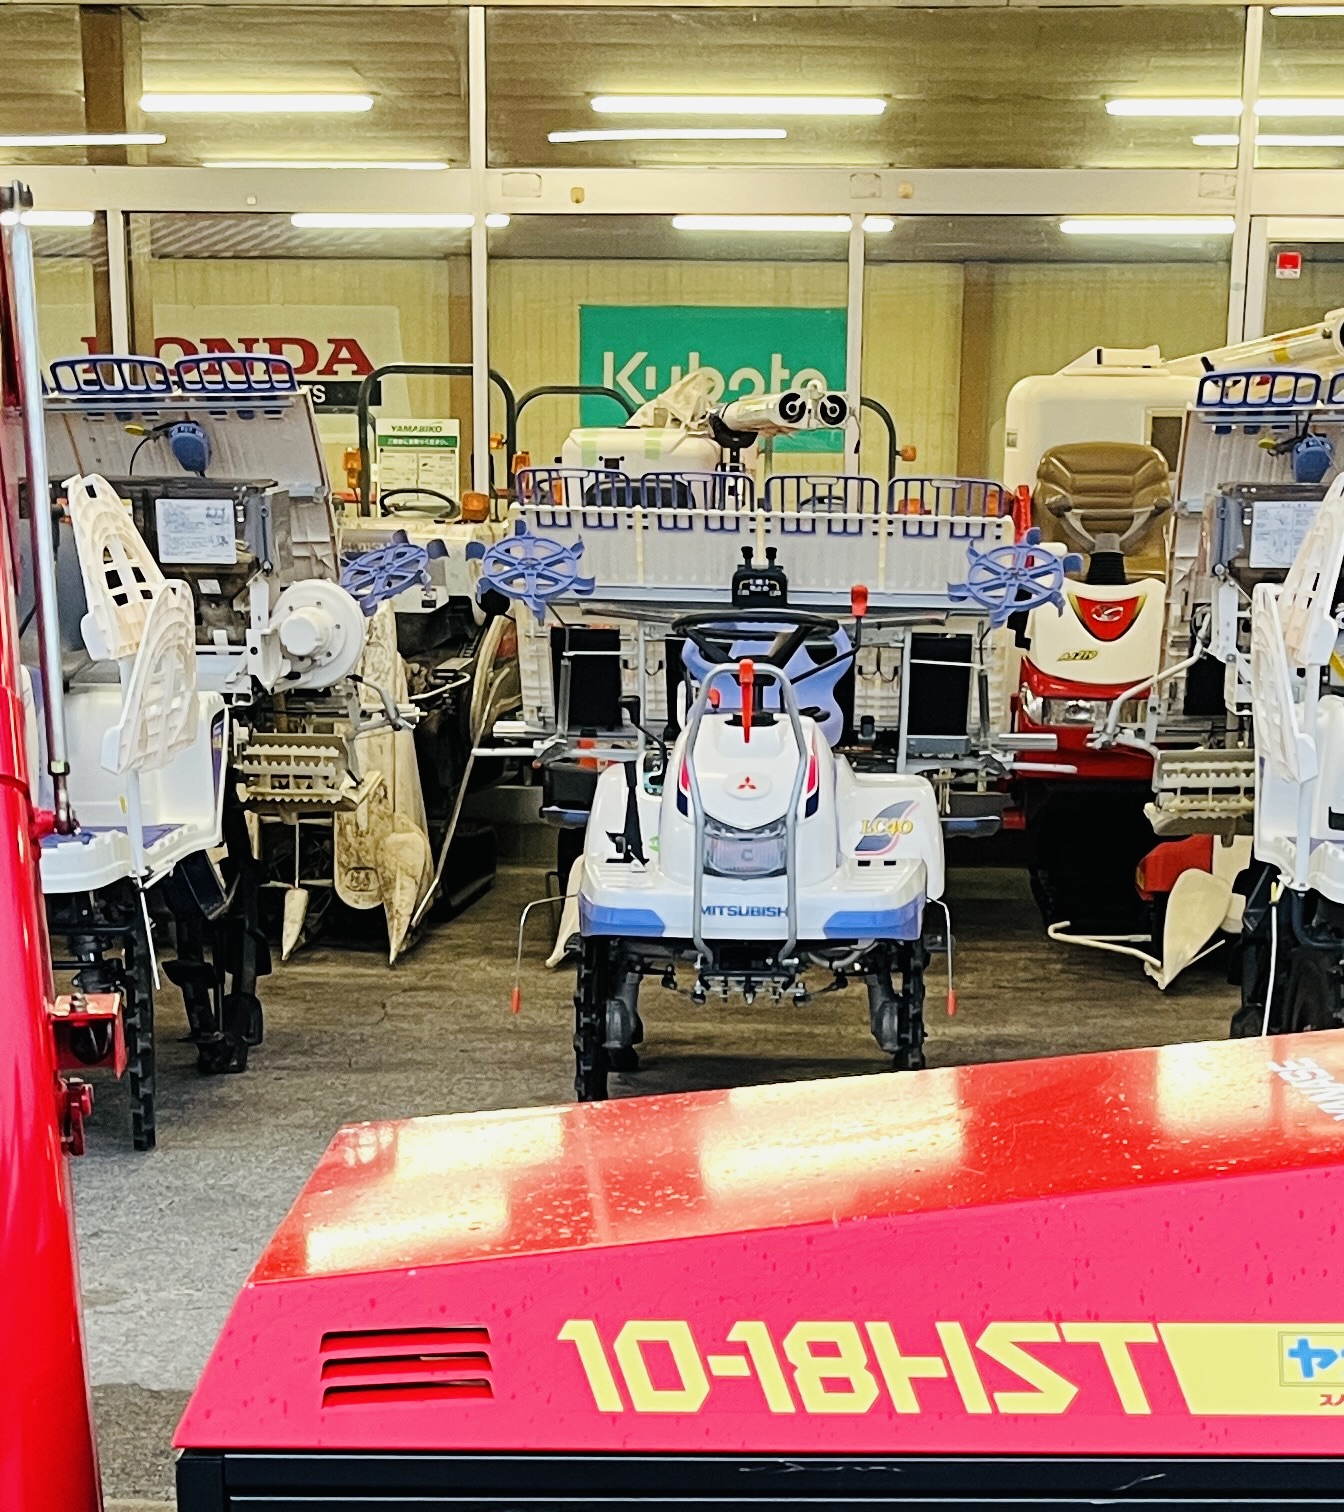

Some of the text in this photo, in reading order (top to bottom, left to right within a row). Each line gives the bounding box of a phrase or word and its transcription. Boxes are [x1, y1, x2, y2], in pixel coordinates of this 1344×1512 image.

[859, 819, 914, 836] LC40
[702, 904, 789, 918] MITSUBISH
[557, 1319, 1159, 1415] 10-18HST
